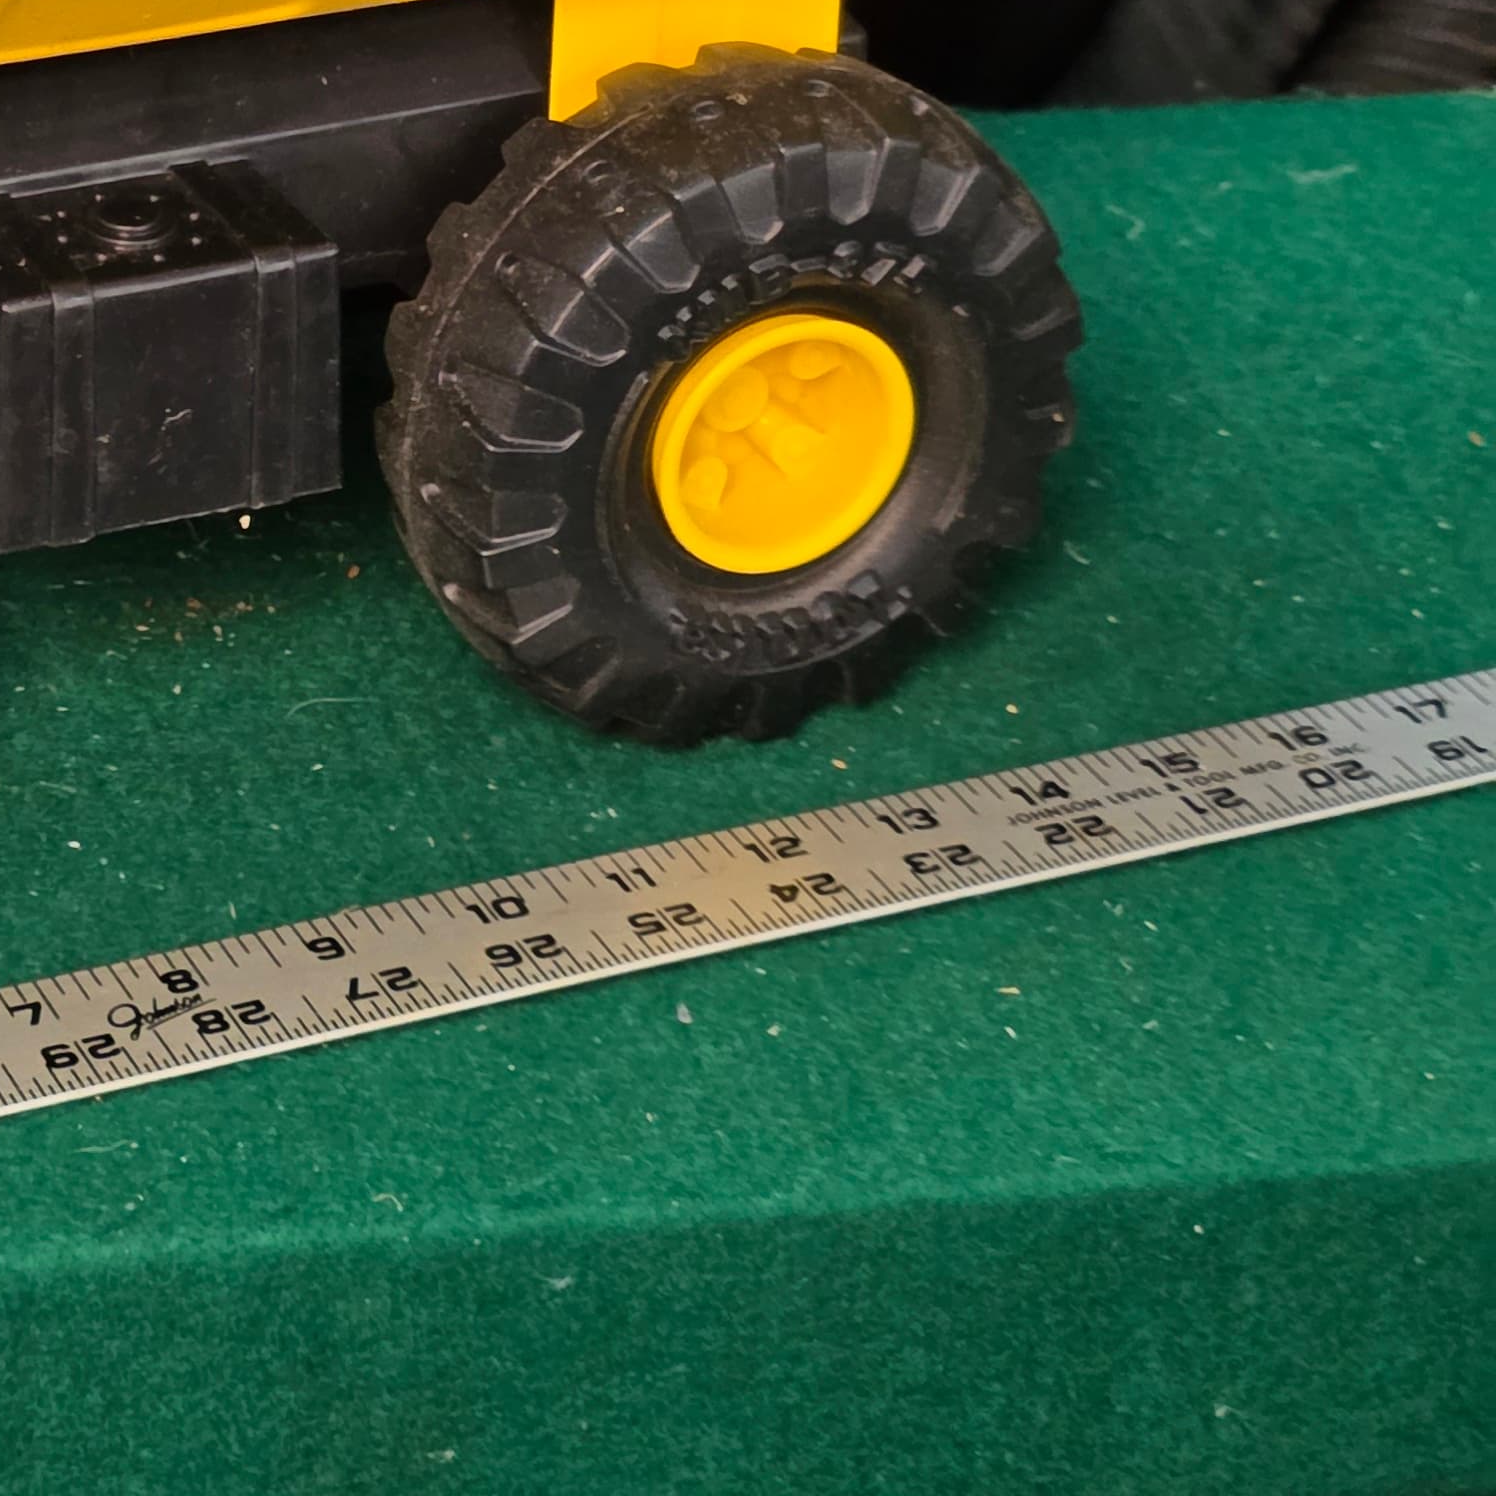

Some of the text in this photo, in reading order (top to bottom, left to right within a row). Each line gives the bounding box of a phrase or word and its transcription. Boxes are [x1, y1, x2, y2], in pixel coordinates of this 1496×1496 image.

[1427, 735, 1489, 762] 19
[1297, 759, 1374, 789] 20
[1007, 799, 1102, 827] JOHNSON
[1107, 786, 1161, 805] LEVEL
[1185, 771, 1236, 789] TOOL
[1179, 787, 1249, 815] 21
[1035, 815, 1114, 845] 22
[8, 1001, 41, 1025] 7
[159, 969, 198, 993] 8
[306, 936, 346, 960] 9
[465, 896, 530, 924] 10
[605, 868, 657, 892] 11
[744, 836, 809, 863] 12
[877, 808, 939, 834] 13
[1010, 781, 1069, 805] 14
[1140, 752, 1201, 778] 15
[1268, 725, 1328, 751] 16
[1395, 699, 1448, 724] 17
[904, 844, 981, 875] 23
[769, 872, 843, 904] 24
[627, 903, 705, 937] 25
[485, 933, 564, 969] 26
[347, 966, 419, 1002] 27
[191, 1000, 272, 1036] 28
[40, 1033, 122, 1069] 29
